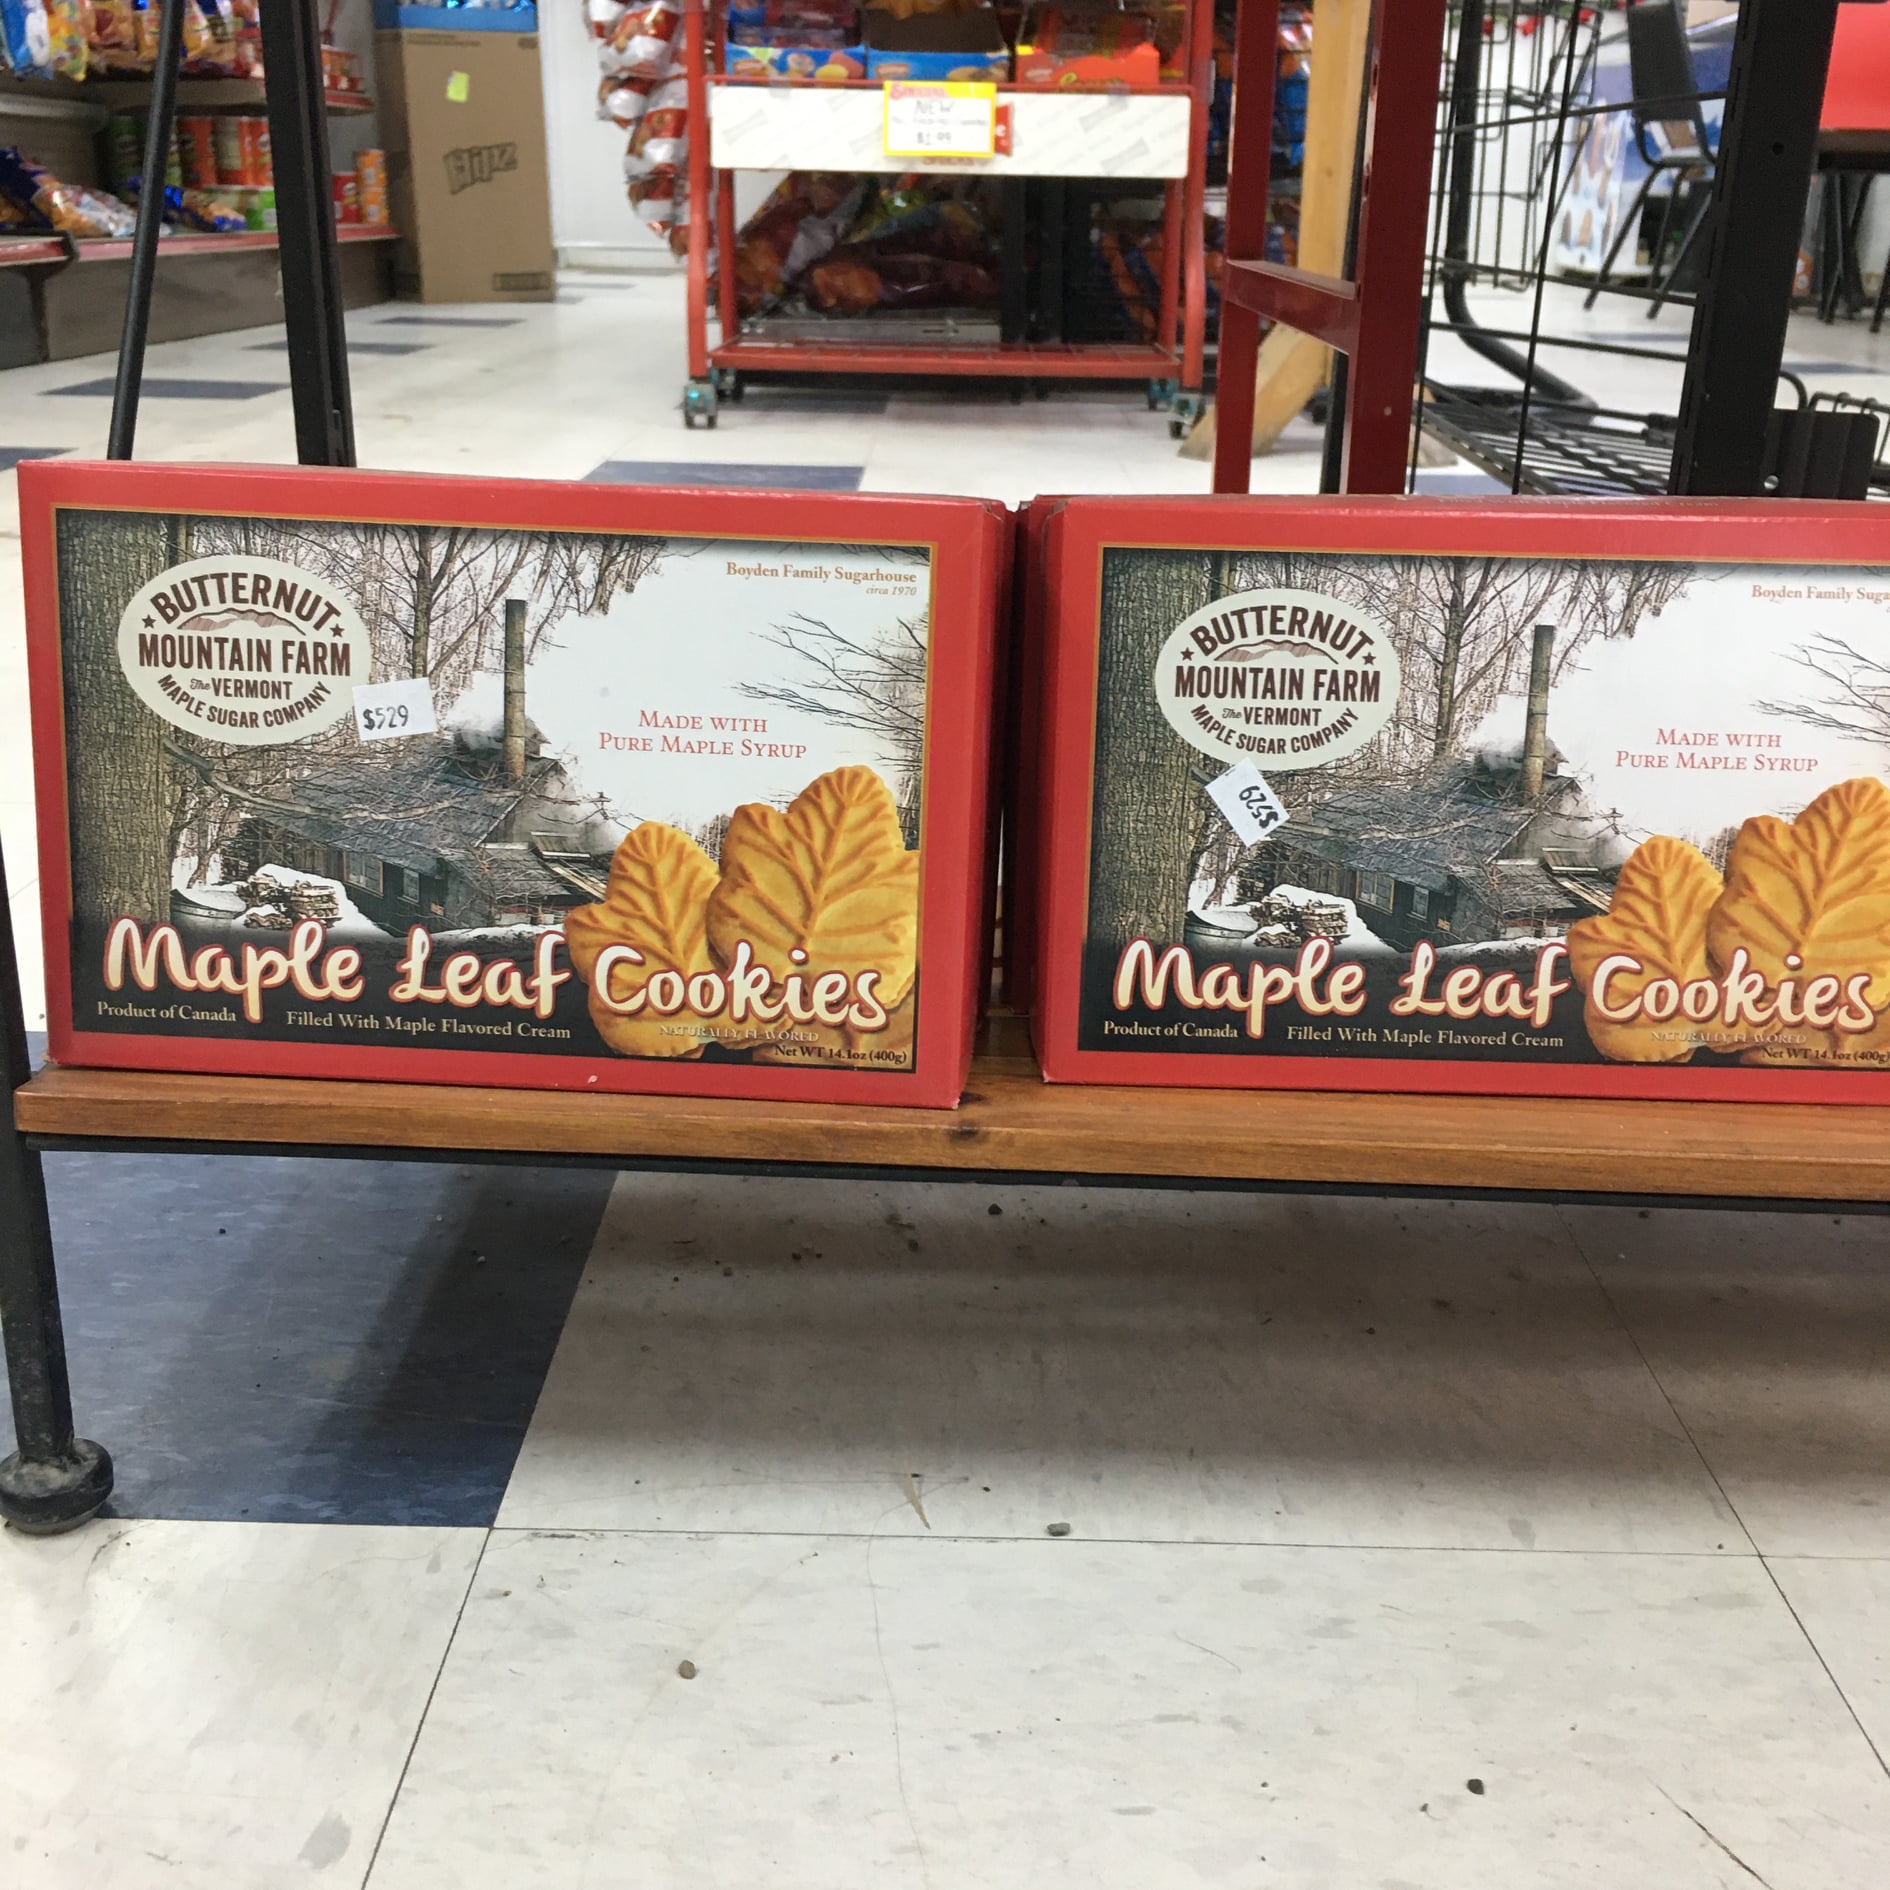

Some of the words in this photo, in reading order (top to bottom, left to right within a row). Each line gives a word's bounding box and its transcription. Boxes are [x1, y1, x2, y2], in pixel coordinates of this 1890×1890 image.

[726, 561, 779, 580] Boyden
[783, 564, 832, 583] Family
[834, 566, 917, 584] Sugarhouse
[150, 572, 342, 631] BUTTERNUT
[865, 585, 889, 596] circa
[890, 585, 917, 597] 1970
[1751, 584, 1803, 604] Boyden
[1806, 585, 1853, 604] Family
[1189, 604, 1375, 660] BUTTERNUT
[138, 633, 273, 673] MOUNTAIN
[281, 640, 351, 677] FARM
[190, 677, 211, 691] The
[211, 677, 294, 701] VERMONT
[1174, 665, 1304, 701] MOUNTAIN
[1312, 668, 1381, 702] FARM
[157, 673, 205, 719] MAPLE
[206, 704, 260, 729] SUGAR
[263, 680, 332, 728] COMPANY
[1221, 707, 1242, 720] The
[1242, 706, 1322, 727] VERMONT
[1190, 703, 1233, 746] MAPLE
[1236, 735, 1287, 755] SUGAR
[1290, 707, 1360, 753] COMPANY
[103, 916, 365, 1024] Maple
[389, 923, 572, 1019] Leaf
[593, 938, 891, 1031] Cookies
[1113, 935, 1369, 1040] Maple
[1389, 939, 1571, 1029] Leaf
[1591, 945, 1876, 1033] Cookies
[97, 1001, 157, 1019] Product
[159, 1003, 177, 1019] of
[179, 1004, 237, 1022] Canada
[286, 1010, 334, 1028] Filled
[338, 1012, 381, 1030] With
[385, 1015, 437, 1034] Maple
[441, 1018, 513, 1037] Flavored
[516, 1021, 571, 1039] Cream
[659, 1024, 742, 1039] NATURALLY
[1104, 1019, 1161, 1037] Product
[1163, 1021, 1181, 1037] of
[1182, 1022, 1238, 1039] Canada
[1287, 1025, 1332, 1041] Filled
[1337, 1027, 1378, 1043] With
[1382, 1028, 1433, 1046] Maple
[1437, 1030, 1508, 1046] Flavored
[1511, 1032, 1565, 1048] Cream
[774, 1045, 798, 1057] Net
[800, 1046, 825, 1058] WT
[829, 1048, 867, 1060] 14.1oz
[869, 1050, 908, 1064] (400g)
[1762, 1047, 1784, 1058] Net
[1785, 1047, 1810, 1059] WT
[1813, 1050, 1851, 1061] 14.1oz
